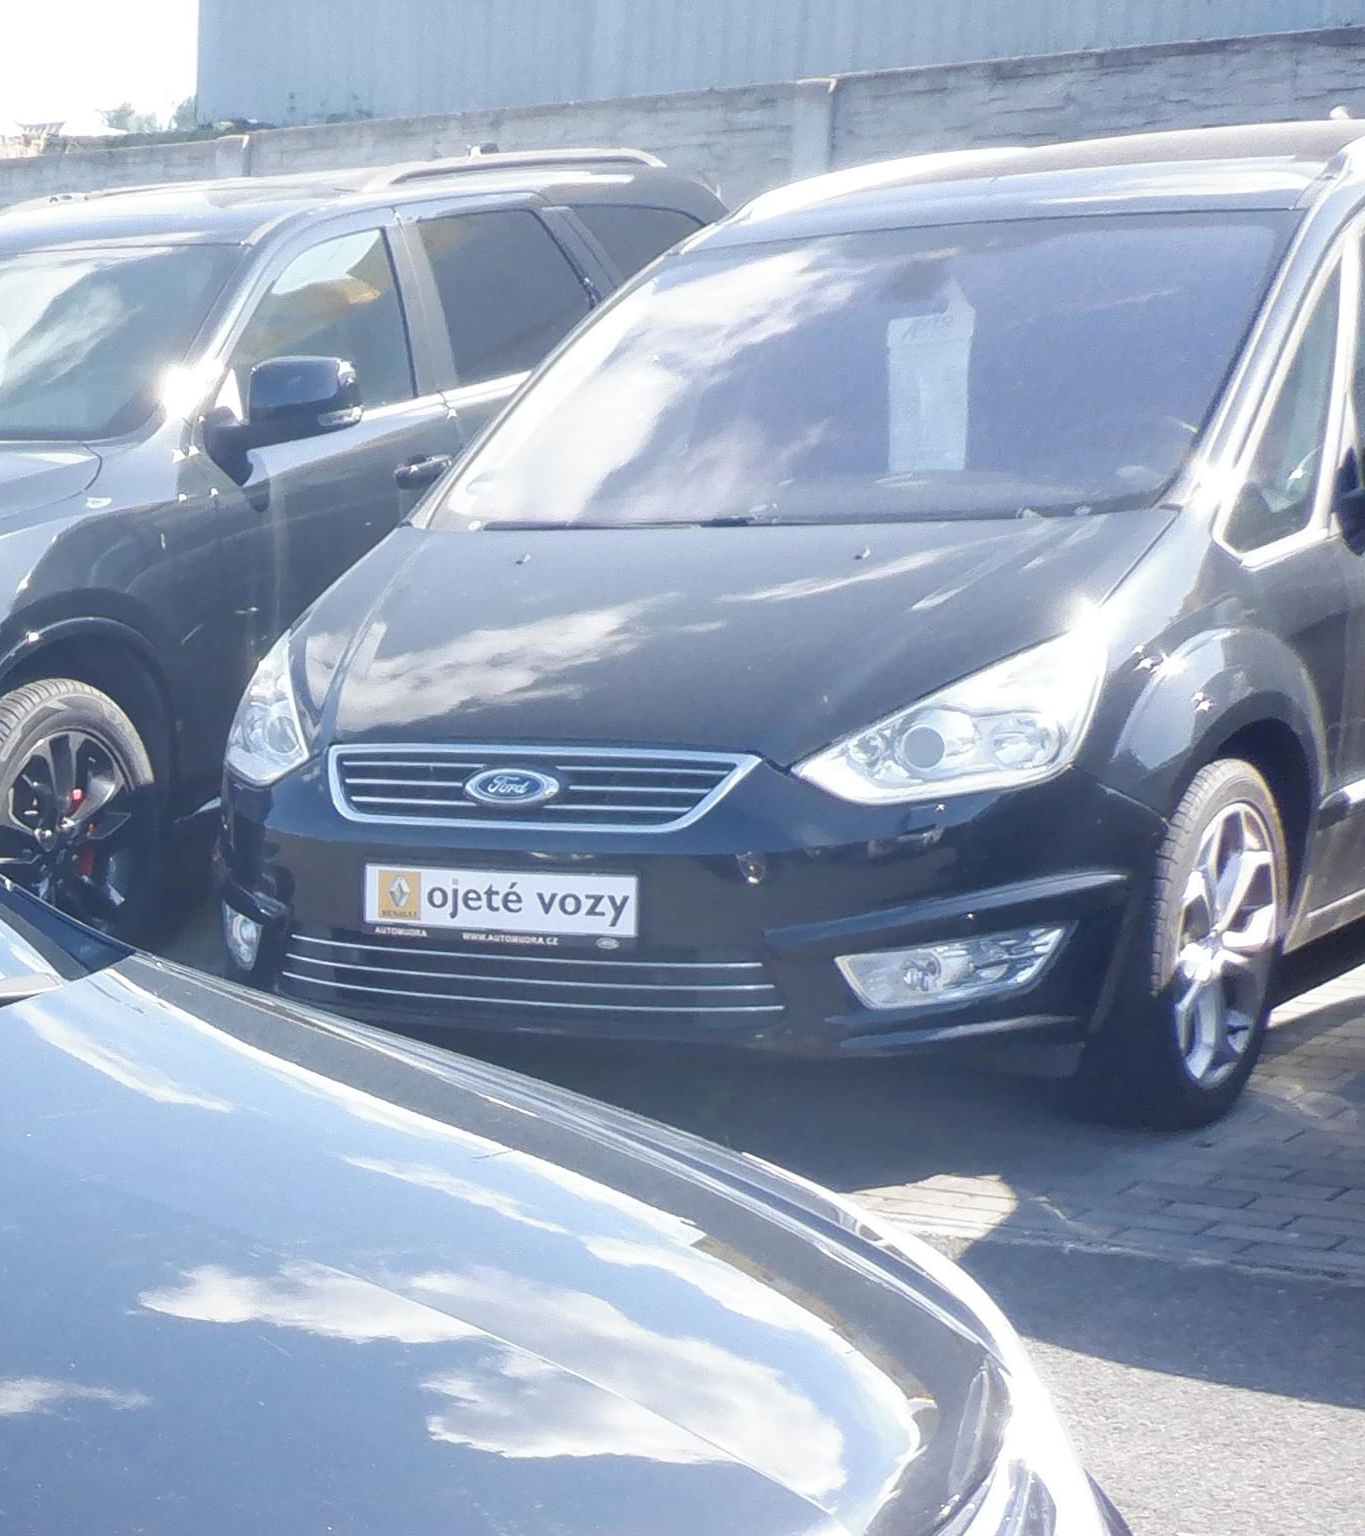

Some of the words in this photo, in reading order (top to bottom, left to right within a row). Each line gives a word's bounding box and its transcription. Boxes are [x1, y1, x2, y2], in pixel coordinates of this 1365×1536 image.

[487, 775, 531, 794] Ford
[426, 878, 523, 919] ojeté
[536, 892, 630, 927] vozy
